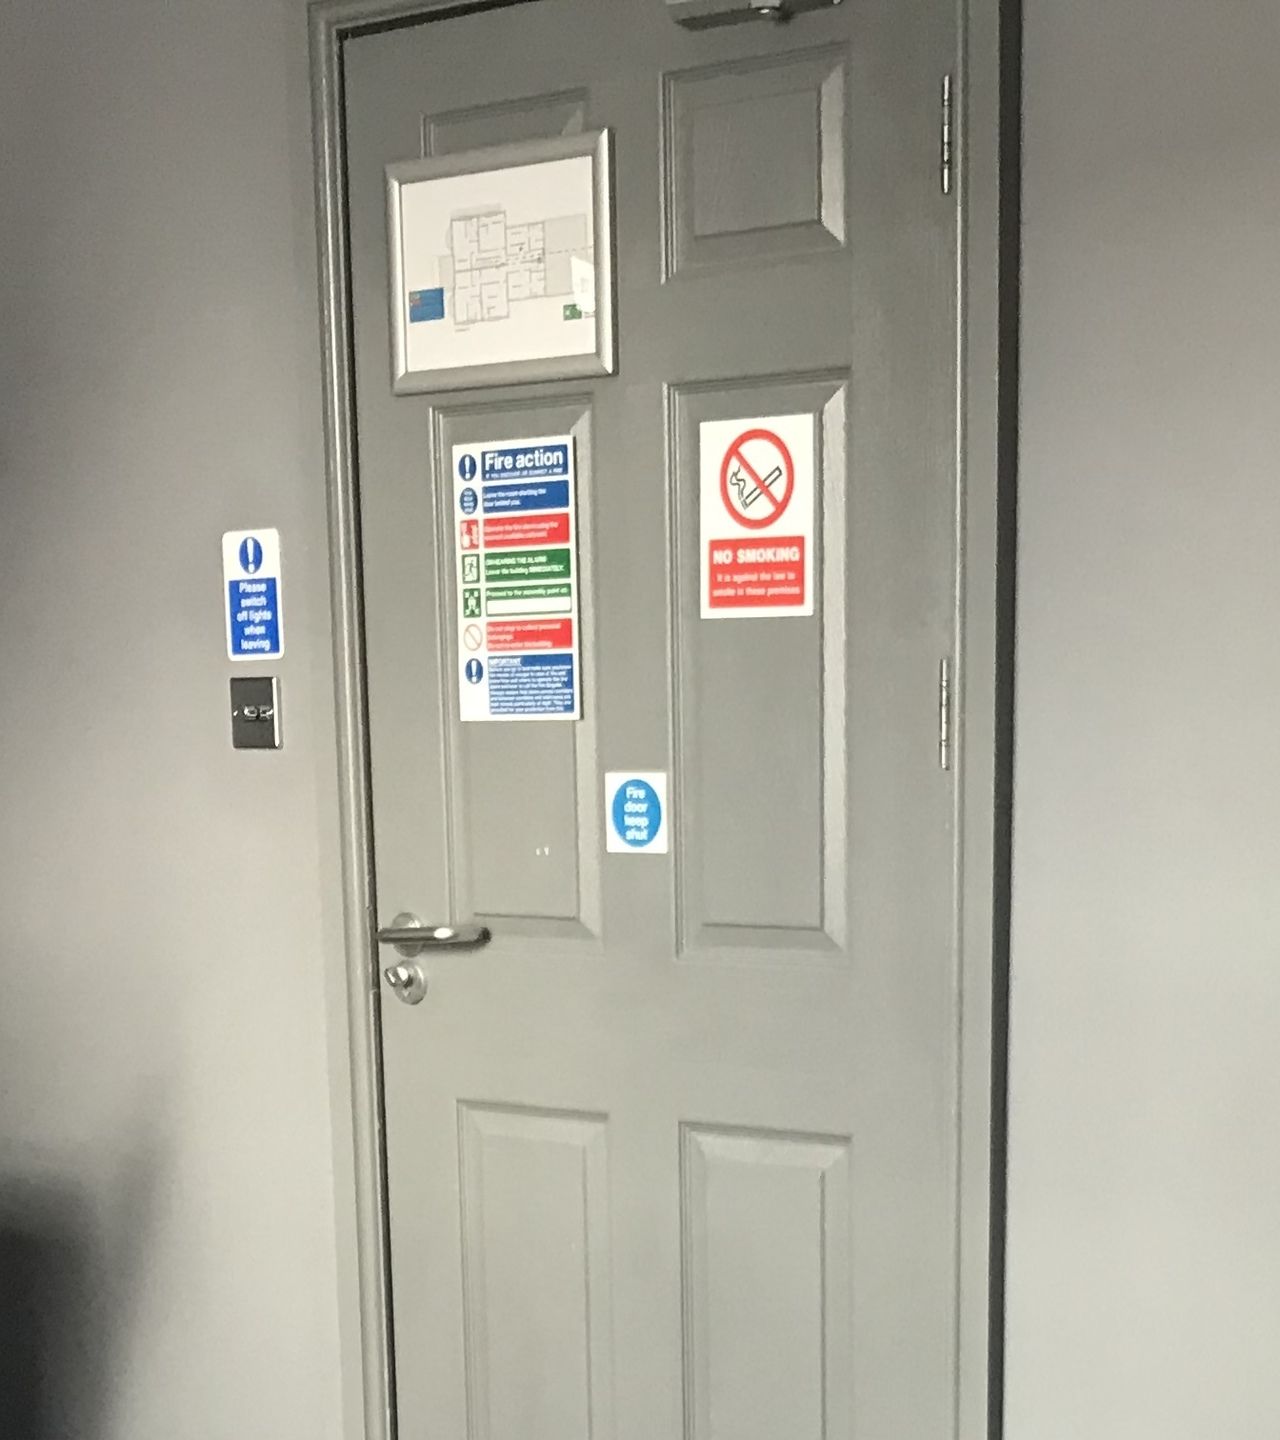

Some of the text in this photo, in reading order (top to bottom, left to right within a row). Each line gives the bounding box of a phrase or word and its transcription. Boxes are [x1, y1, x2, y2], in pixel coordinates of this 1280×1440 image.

[485, 449, 564, 471] Fire action
[713, 546, 800, 565] NO SMOKING
[239, 582, 267, 593] Please
[236, 609, 272, 623] off lights
[240, 639, 271, 651] leaving
[626, 786, 646, 799] Fire
[623, 801, 648, 813] door
[623, 814, 650, 829] keep
[625, 828, 648, 840] shut
